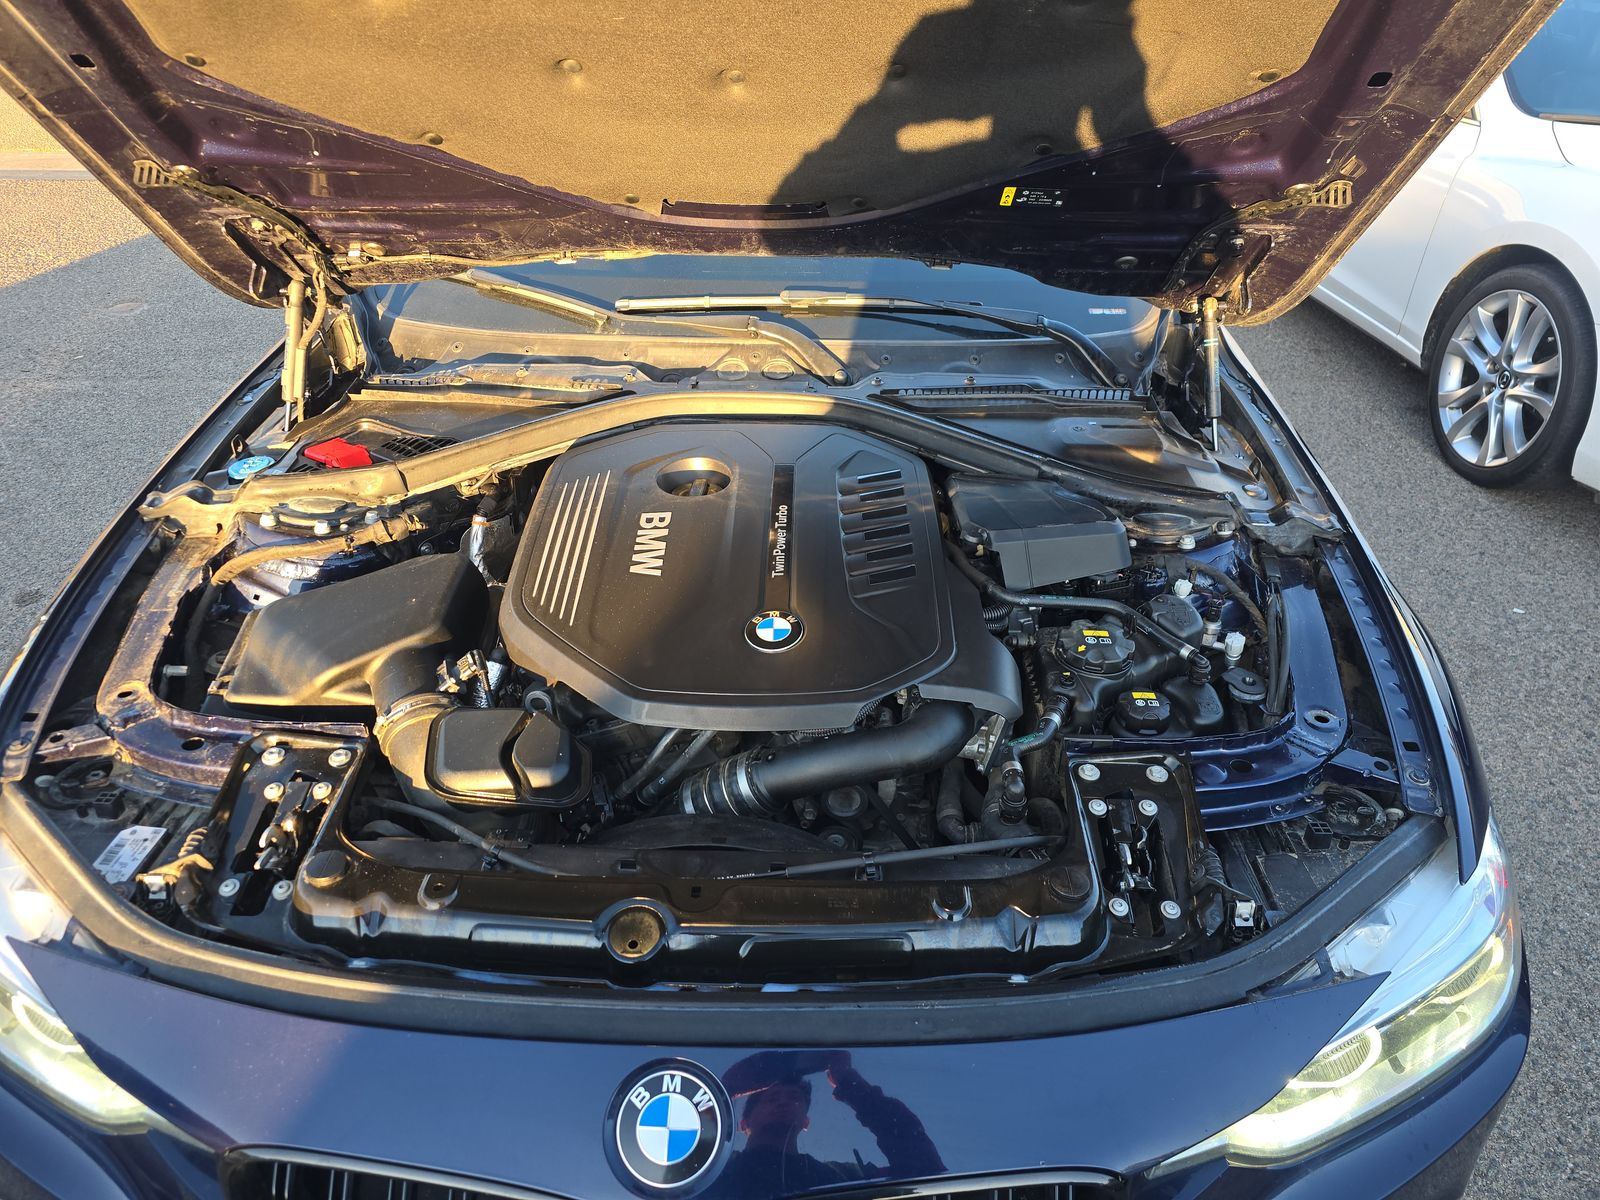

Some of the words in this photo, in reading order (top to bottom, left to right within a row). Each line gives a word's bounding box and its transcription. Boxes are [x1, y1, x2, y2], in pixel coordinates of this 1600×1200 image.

[774, 504, 788, 529] Turbo
[629, 511, 672, 577] BMW
[771, 528, 787, 578] TwinPower
[751, 610, 798, 624] BMW
[629, 1073, 714, 1112] BMW
